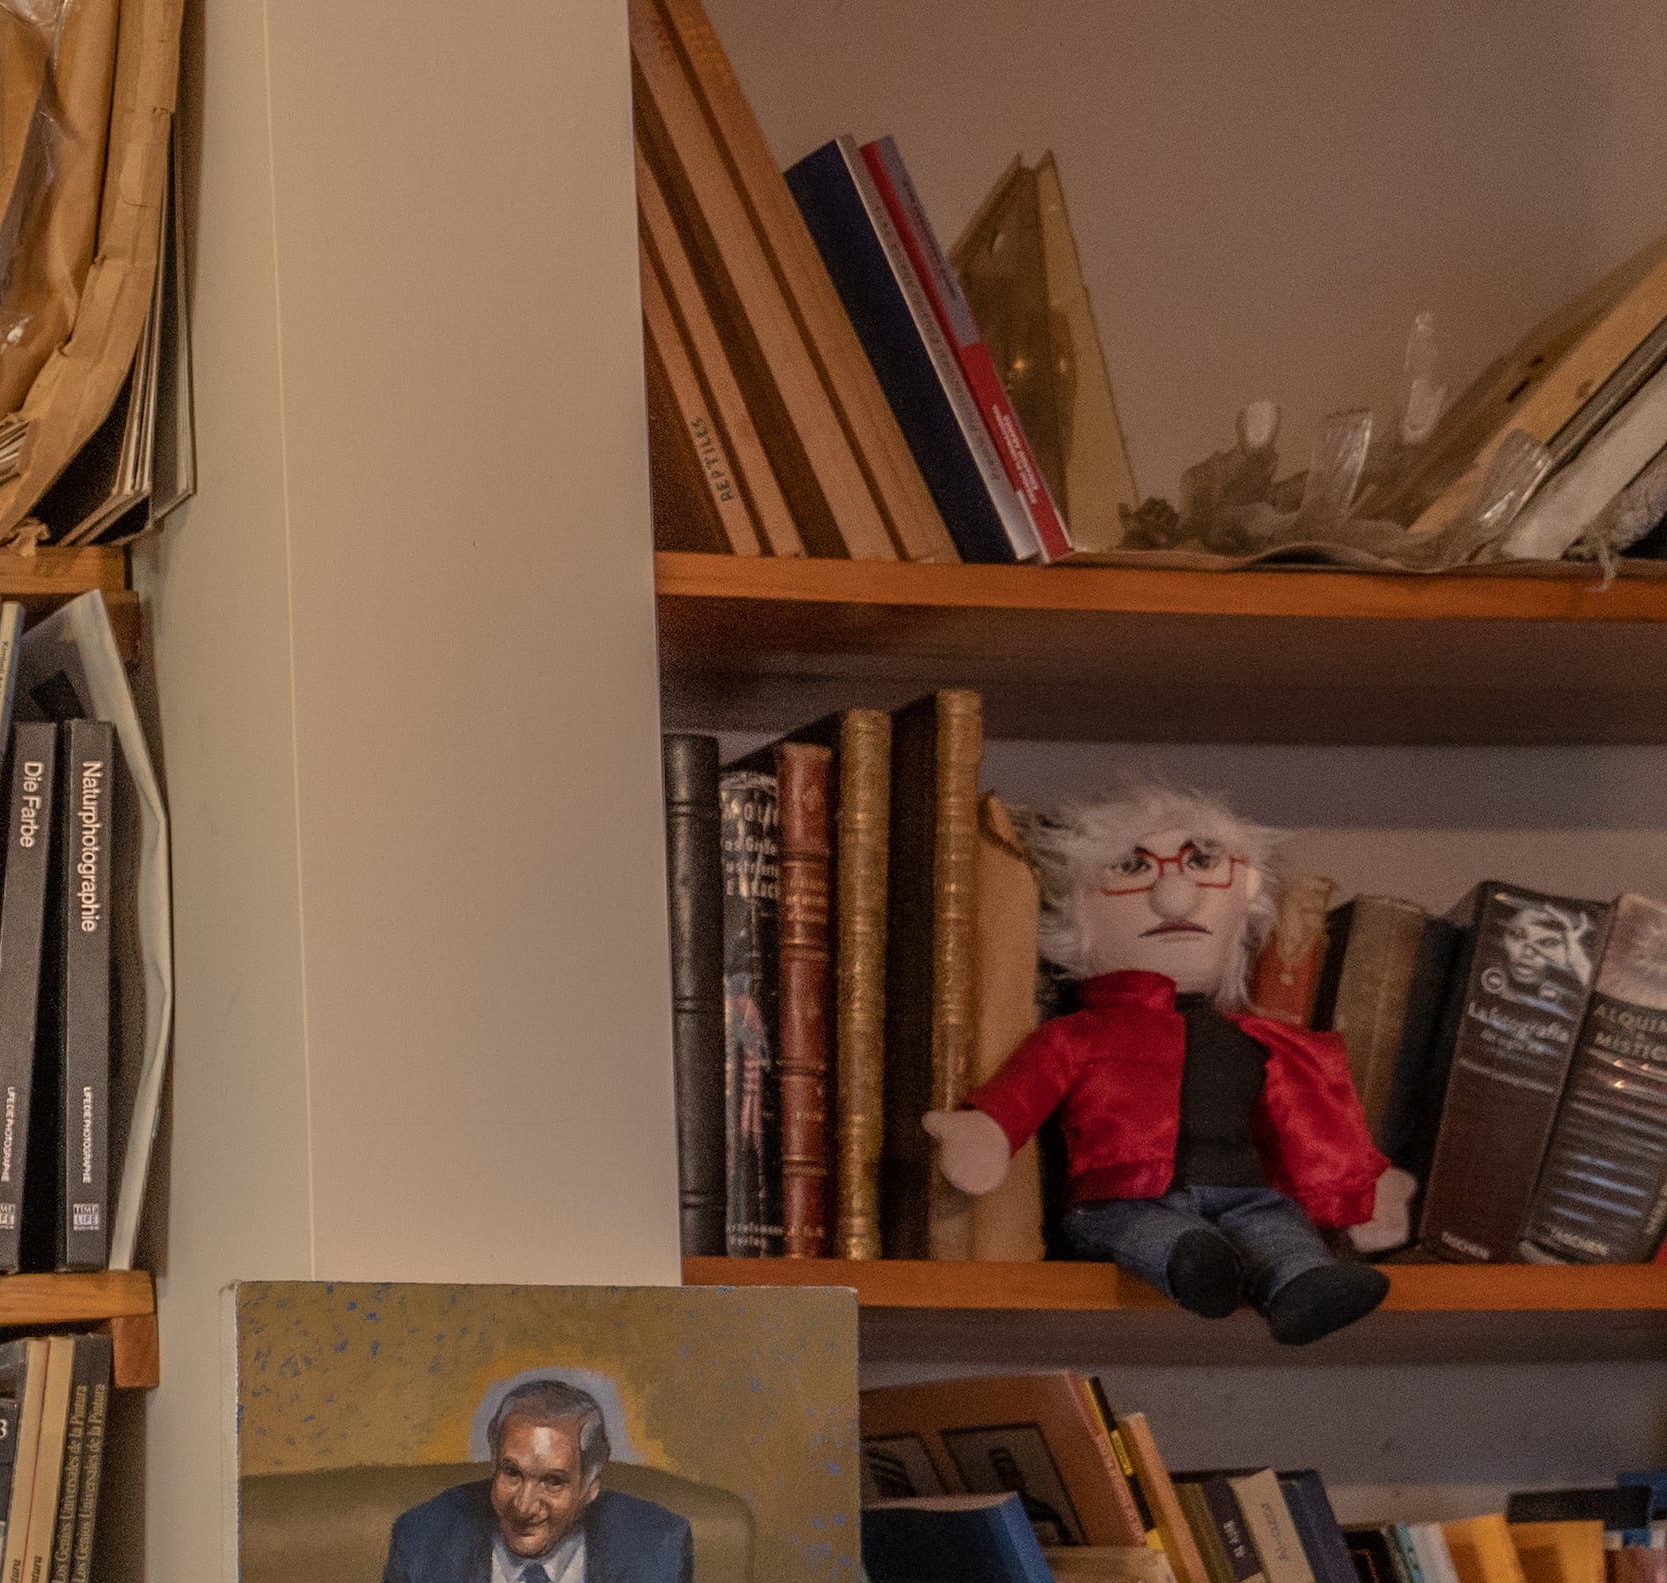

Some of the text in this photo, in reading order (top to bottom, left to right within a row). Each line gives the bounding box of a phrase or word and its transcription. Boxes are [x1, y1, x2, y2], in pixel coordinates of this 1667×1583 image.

[690, 416, 736, 504] REPTILES
[14, 761, 43, 849] Die Farbe
[73, 761, 105, 932] Naturphotographie
